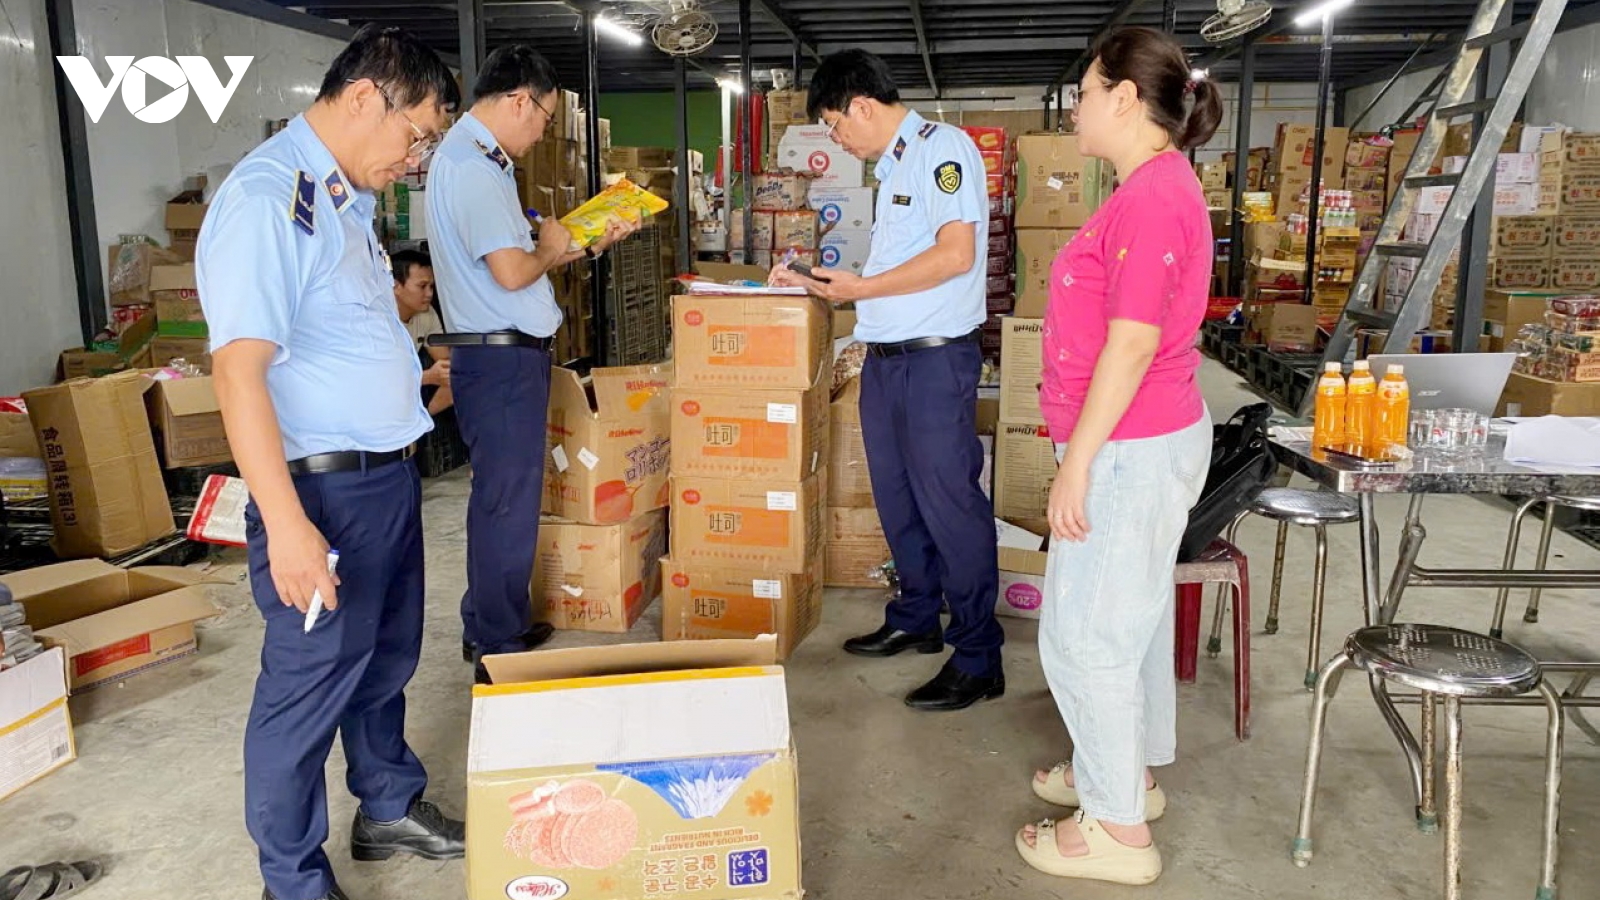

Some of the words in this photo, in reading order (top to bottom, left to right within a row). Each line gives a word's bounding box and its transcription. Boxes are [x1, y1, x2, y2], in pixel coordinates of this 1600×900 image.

[712, 333, 739, 355] 吐司
[706, 425, 733, 446] 吐司
[709, 512, 736, 534] 吐司
[694, 597, 720, 619] 吐司
[696, 839, 714, 848] AND
